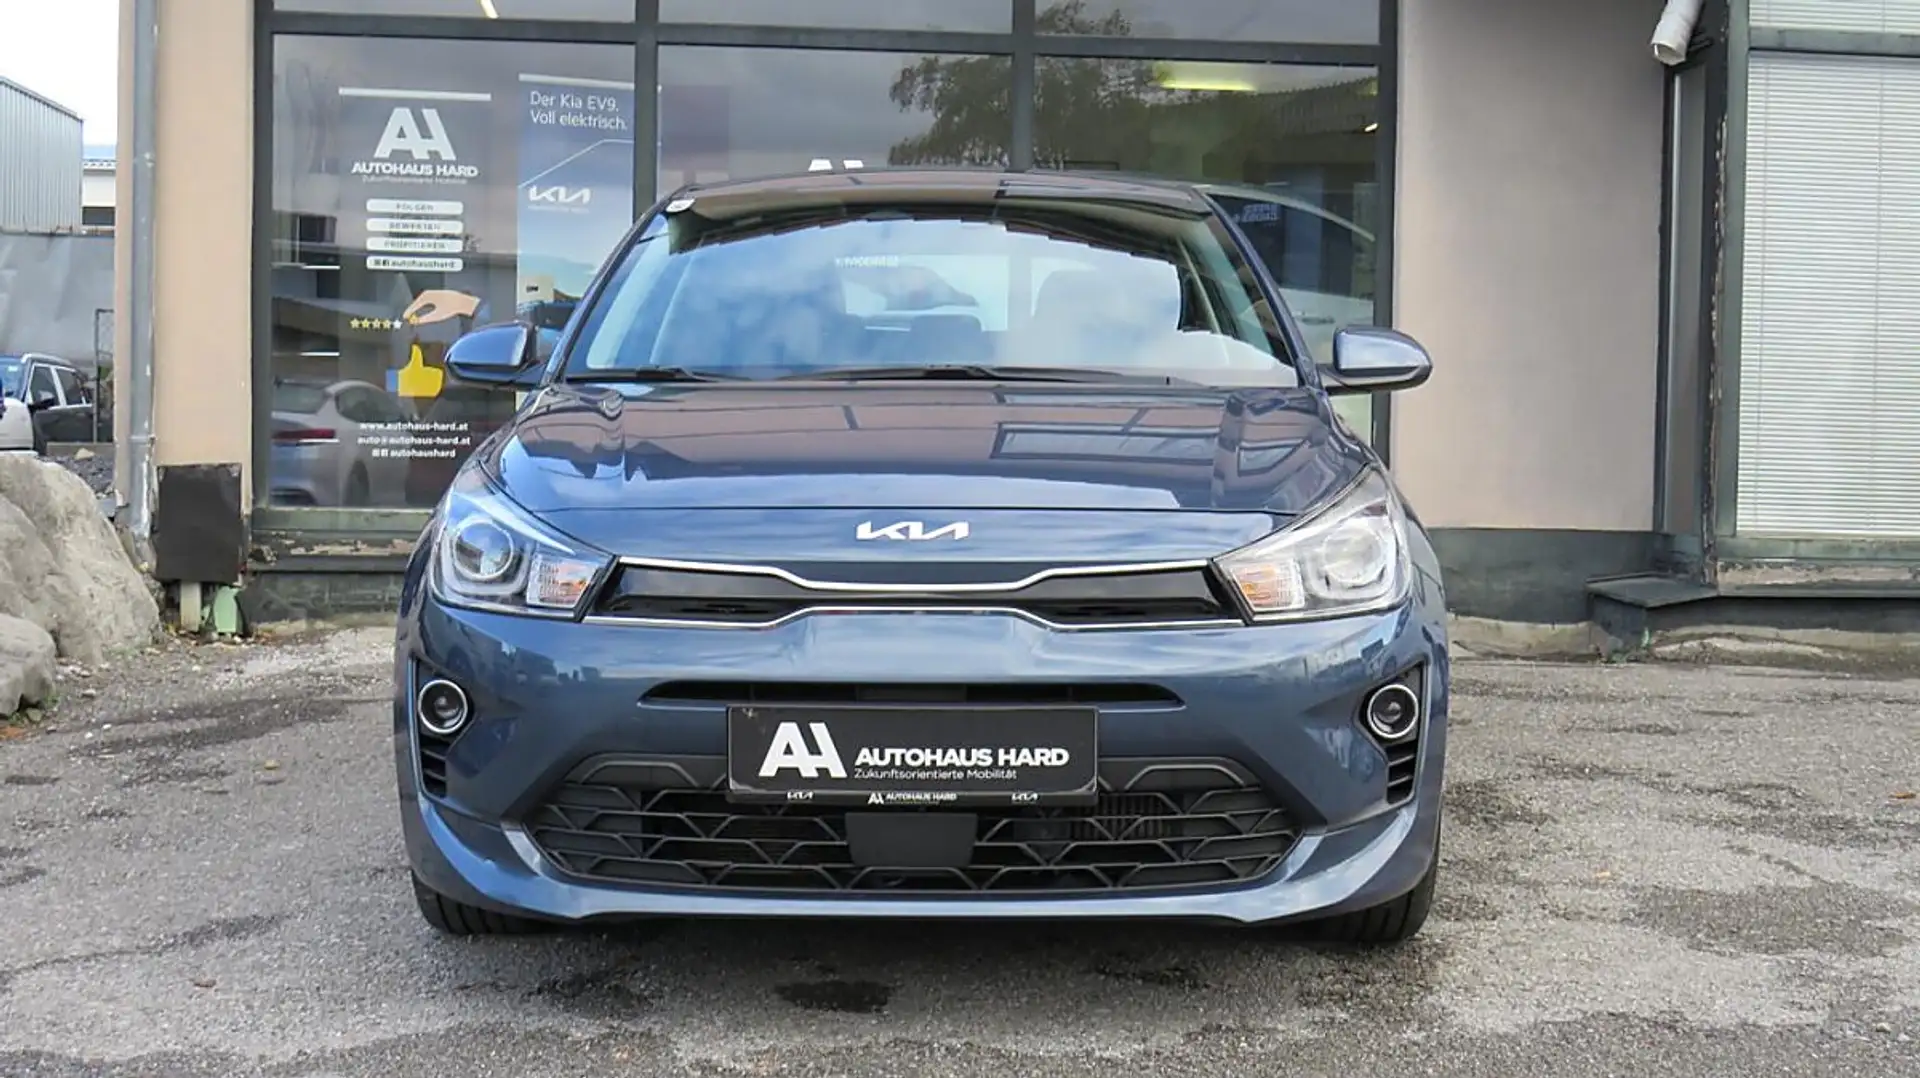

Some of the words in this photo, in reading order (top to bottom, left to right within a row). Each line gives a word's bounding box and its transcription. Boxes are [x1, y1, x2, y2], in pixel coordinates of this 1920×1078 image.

[530, 90, 556, 106] Der
[560, 93, 583, 109] Kia
[587, 95, 620, 112] EV9.
[530, 109, 556, 125] Voll
[559, 111, 628, 131] elektrisch.
[351, 161, 433, 176] AUTOHAUS
[435, 165, 479, 178] HARD
[360, 421, 468, 432] www.autohaus-hard.at
[390, 447, 456, 458] autohaushard
[855, 747, 993, 767] AUTOHAUS
[997, 748, 1070, 767] HARD
[854, 768, 964, 780] Zukunftsorientierte
[966, 768, 1017, 780] Mobilität
